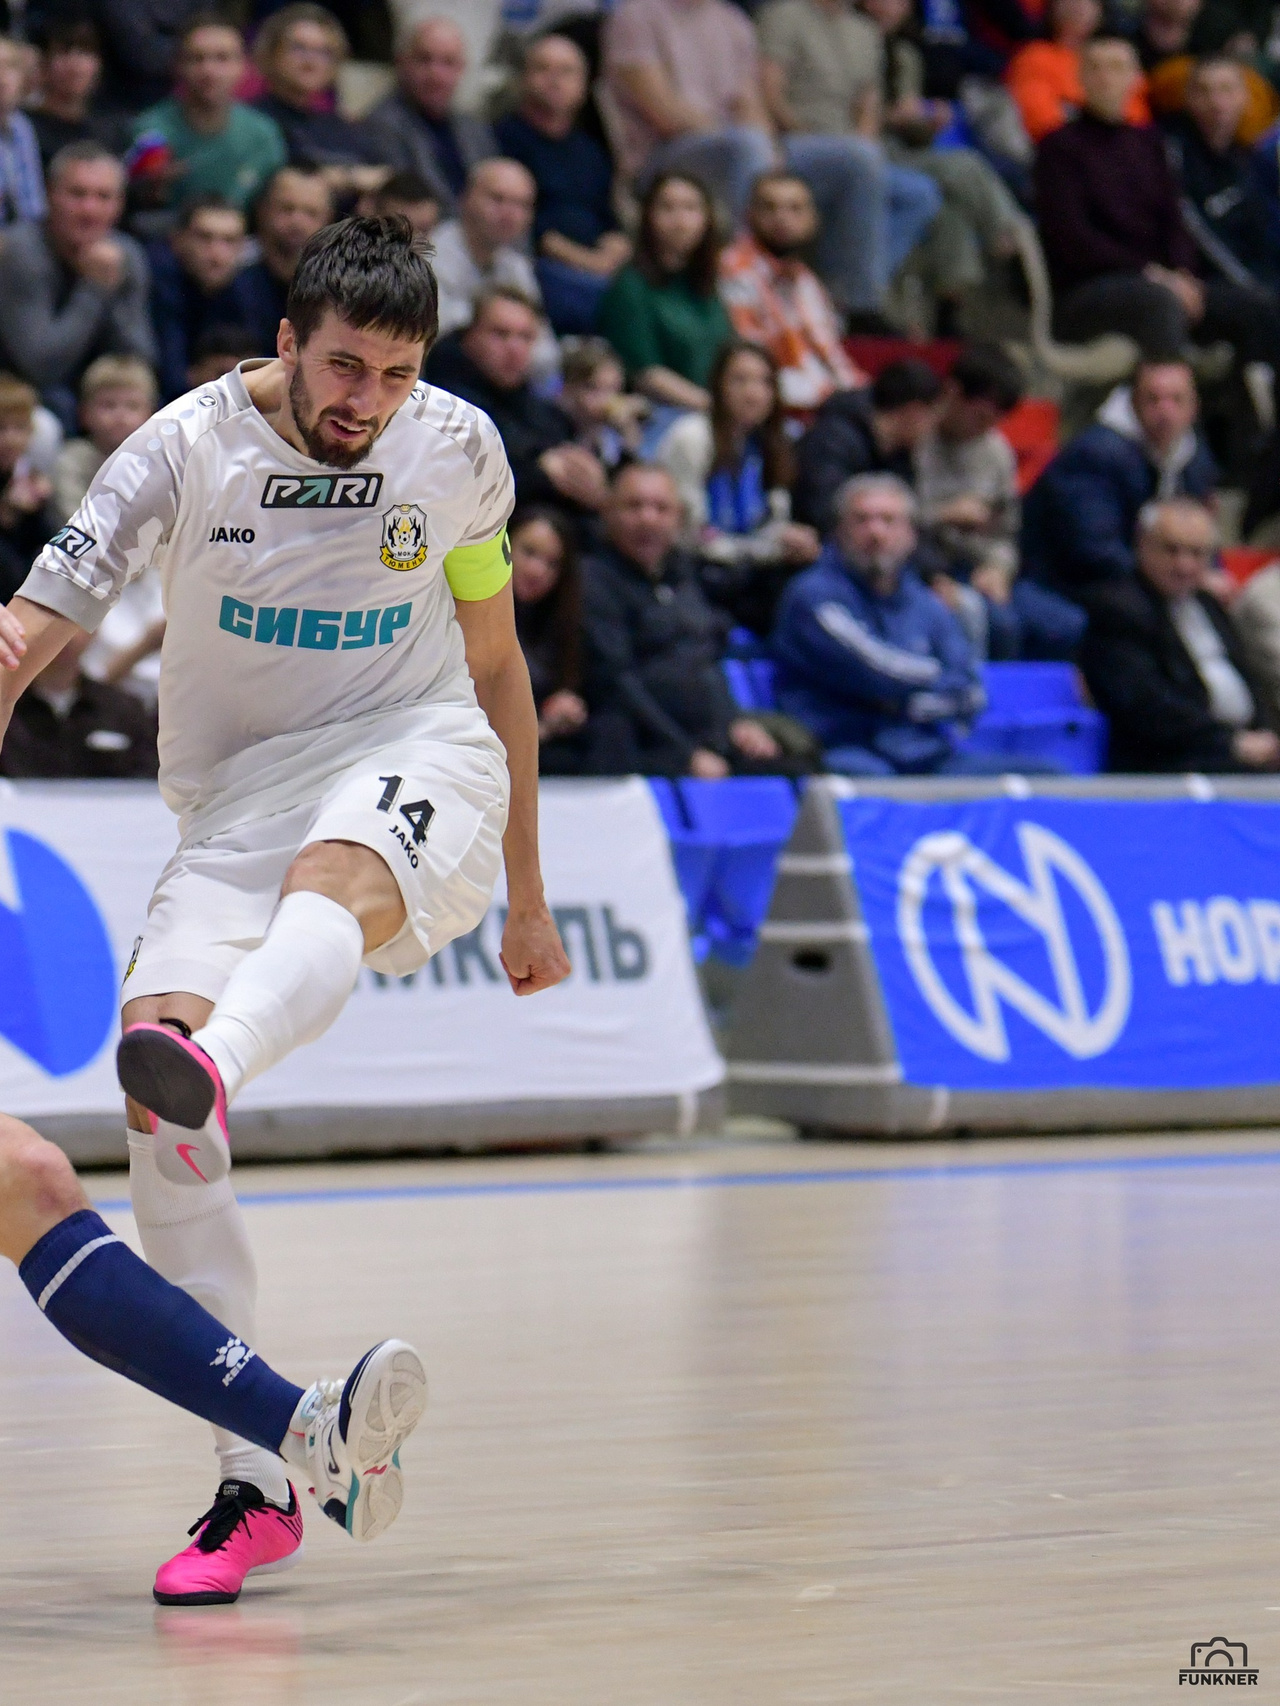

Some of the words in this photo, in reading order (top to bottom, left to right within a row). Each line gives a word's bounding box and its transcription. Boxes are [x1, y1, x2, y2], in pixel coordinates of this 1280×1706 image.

[264, 477, 379, 505] PARI
[48, 526, 93, 557] ARI
[208, 527, 256, 544] JAKO
[383, 556, 423, 569] ТЮМЕНЬ
[219, 595, 413, 650] СИБУР
[376, 775, 436, 847] 14
[388, 825, 419, 869] JAKO
